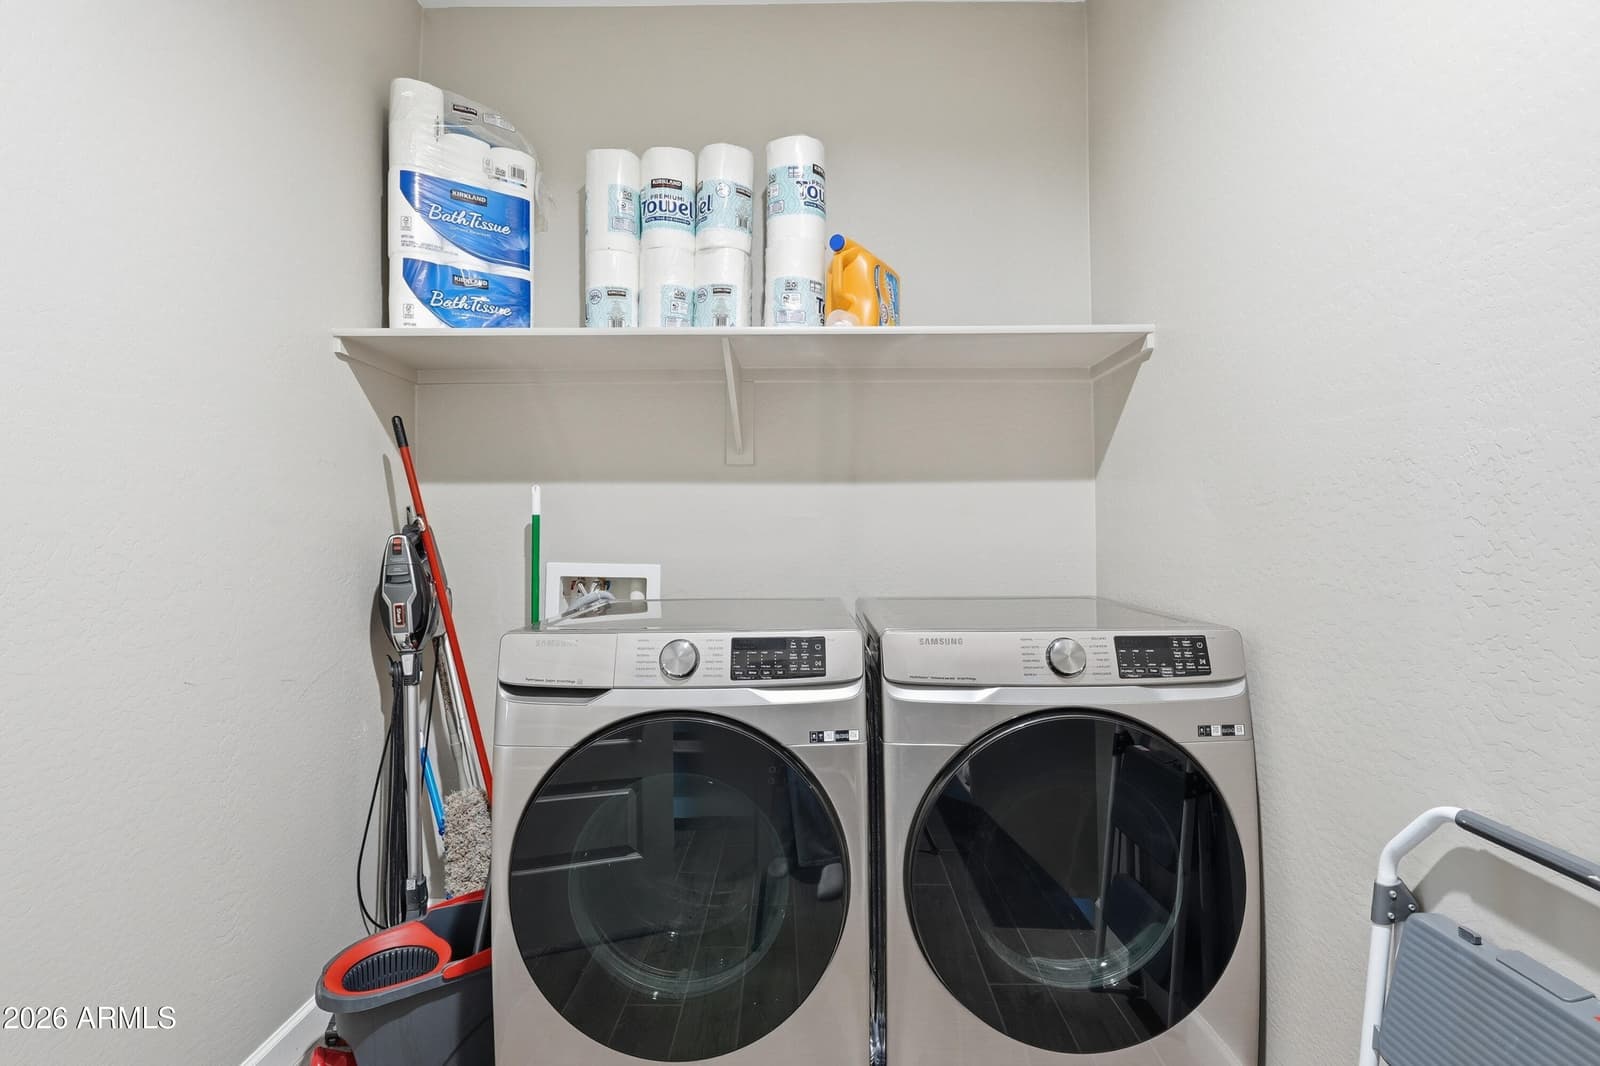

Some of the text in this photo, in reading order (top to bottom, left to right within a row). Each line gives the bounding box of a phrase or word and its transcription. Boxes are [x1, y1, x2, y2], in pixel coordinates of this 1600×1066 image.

[452, 190, 487, 204] KIRKLAND
[650, 193, 684, 202] PREMIUM
[641, 199, 693, 219] Towel
[428, 203, 469, 226] Bath
[468, 211, 511, 235] Tissue
[454, 276, 488, 288] KIRKLAND
[430, 290, 512, 316] Bath Tissue
[919, 637, 964, 646] SAMSUNG
